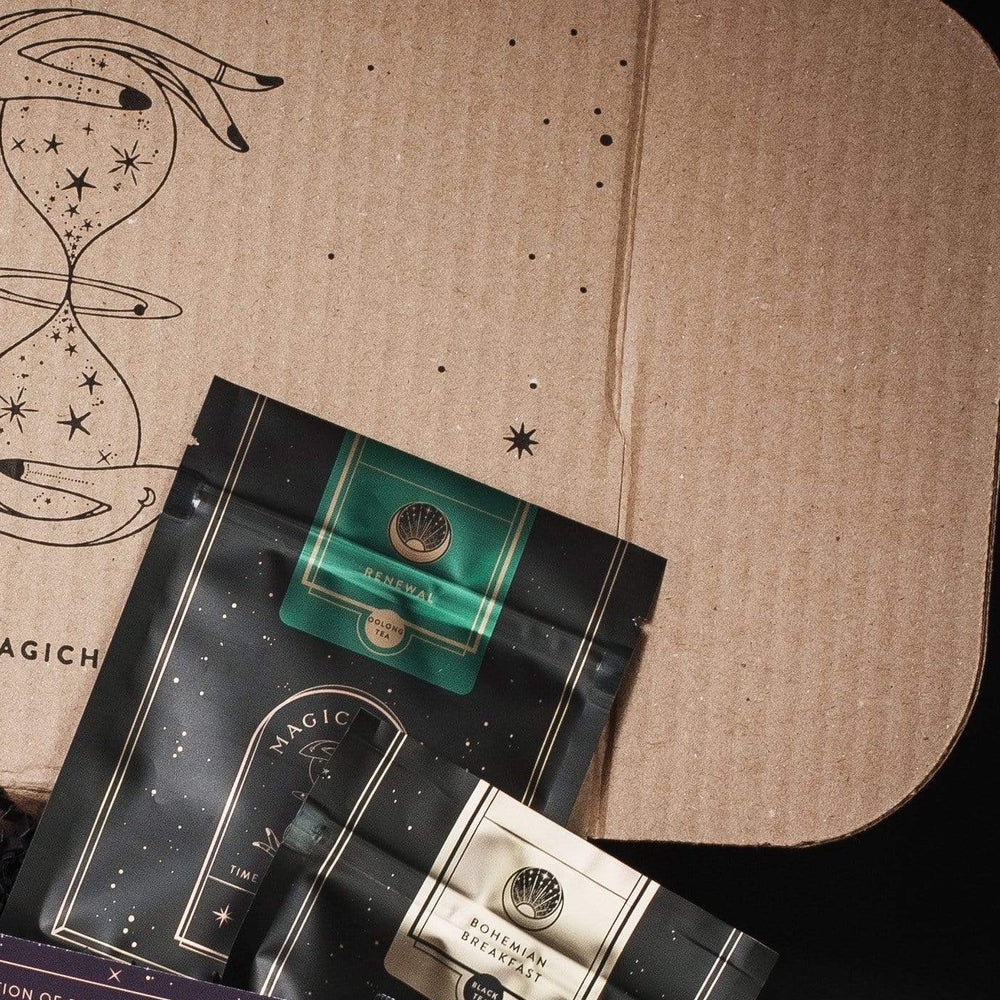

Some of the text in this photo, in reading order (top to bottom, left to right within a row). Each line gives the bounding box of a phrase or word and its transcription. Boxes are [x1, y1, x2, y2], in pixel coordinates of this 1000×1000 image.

[363, 567, 434, 605] RENEWAL
[367, 616, 404, 635] OOLONG
[375, 628, 390, 639] TEA
[269, 709, 350, 755] MAGIC
[229, 864, 259, 883] TIME
[461, 930, 542, 983] BREAKFAST
[470, 917, 547, 968] BOHEMIAN
[471, 981, 499, 1000] BLACK
